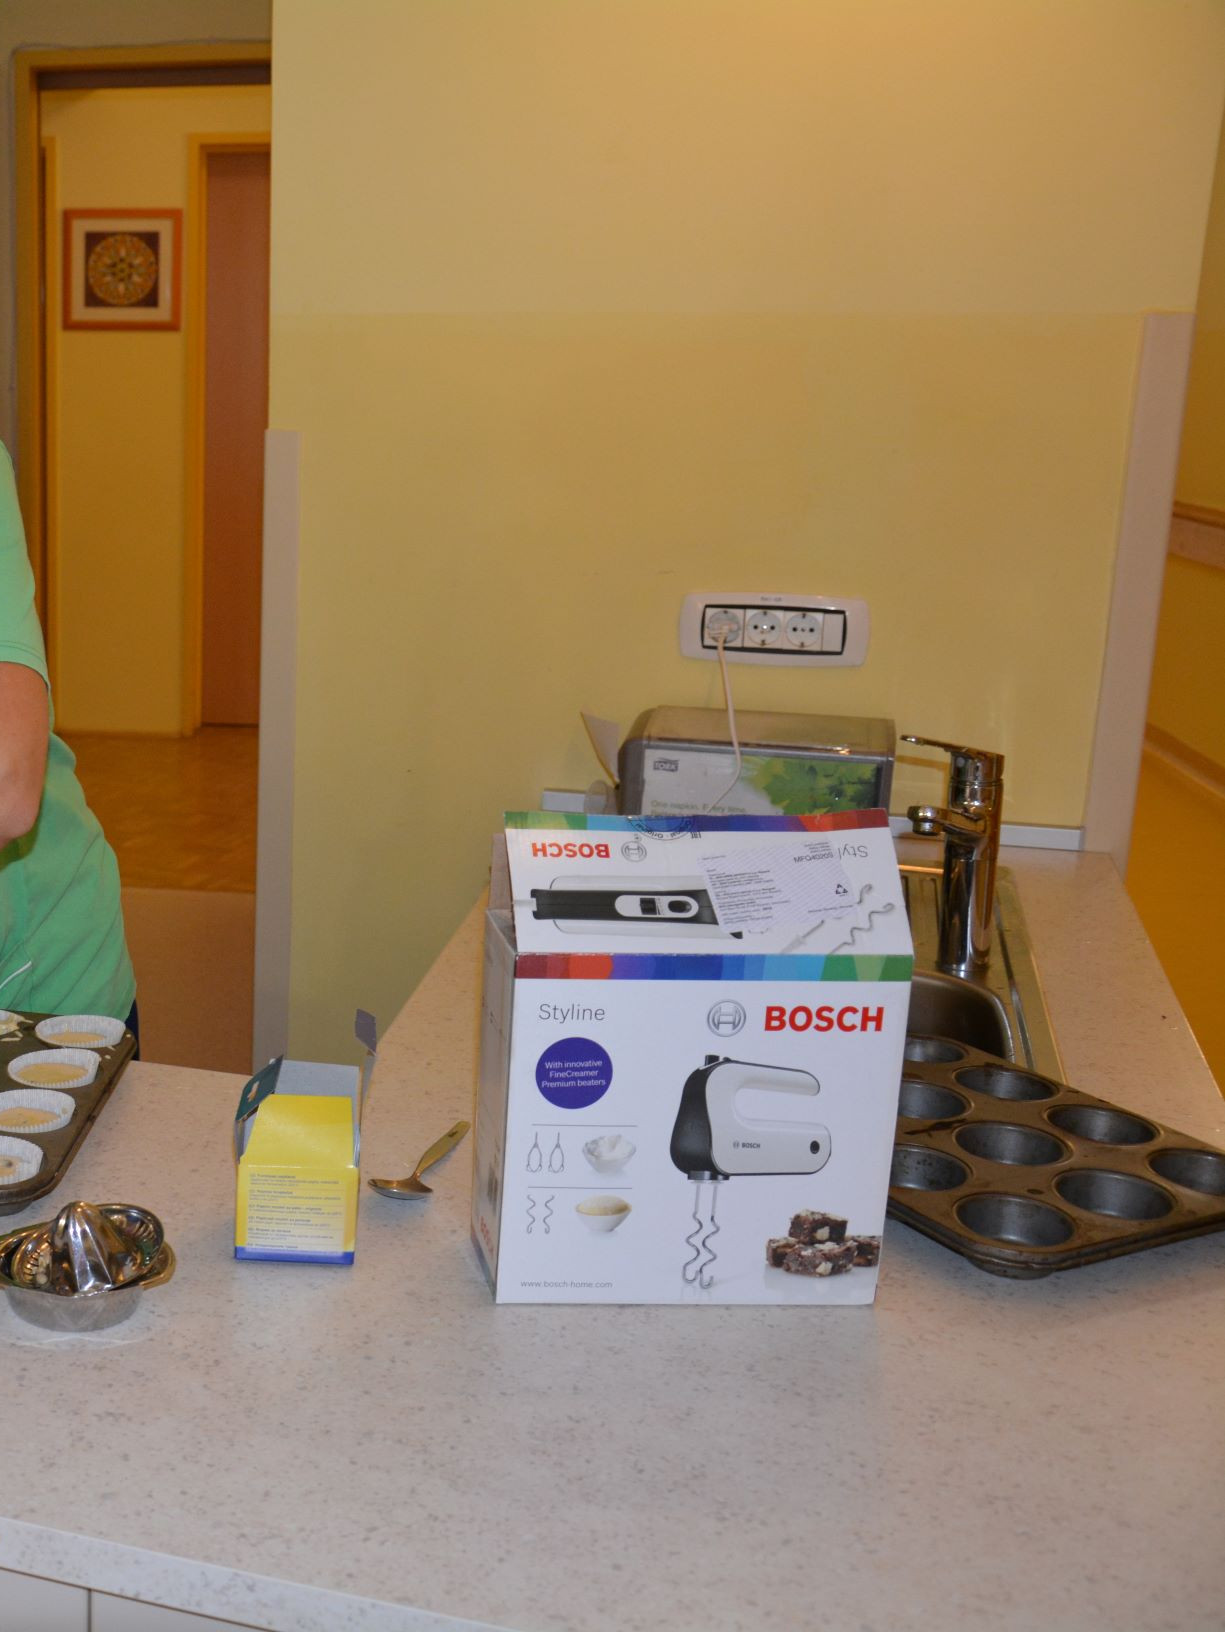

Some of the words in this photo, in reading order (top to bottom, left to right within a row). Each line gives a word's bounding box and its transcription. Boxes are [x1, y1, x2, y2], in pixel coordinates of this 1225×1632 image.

[531, 842, 611, 859] BOSCH
[838, 843, 869, 861] Styl
[538, 1003, 606, 1024] Styline
[763, 1005, 885, 1033] BOSCH
[545, 1061, 563, 1069] With
[564, 1060, 603, 1068] innovative
[549, 1069, 599, 1078] FineCreamer
[541, 1080, 576, 1088] Premium
[577, 1079, 606, 1087] beaters
[520, 1279, 613, 1289] www.bosch-home.com
